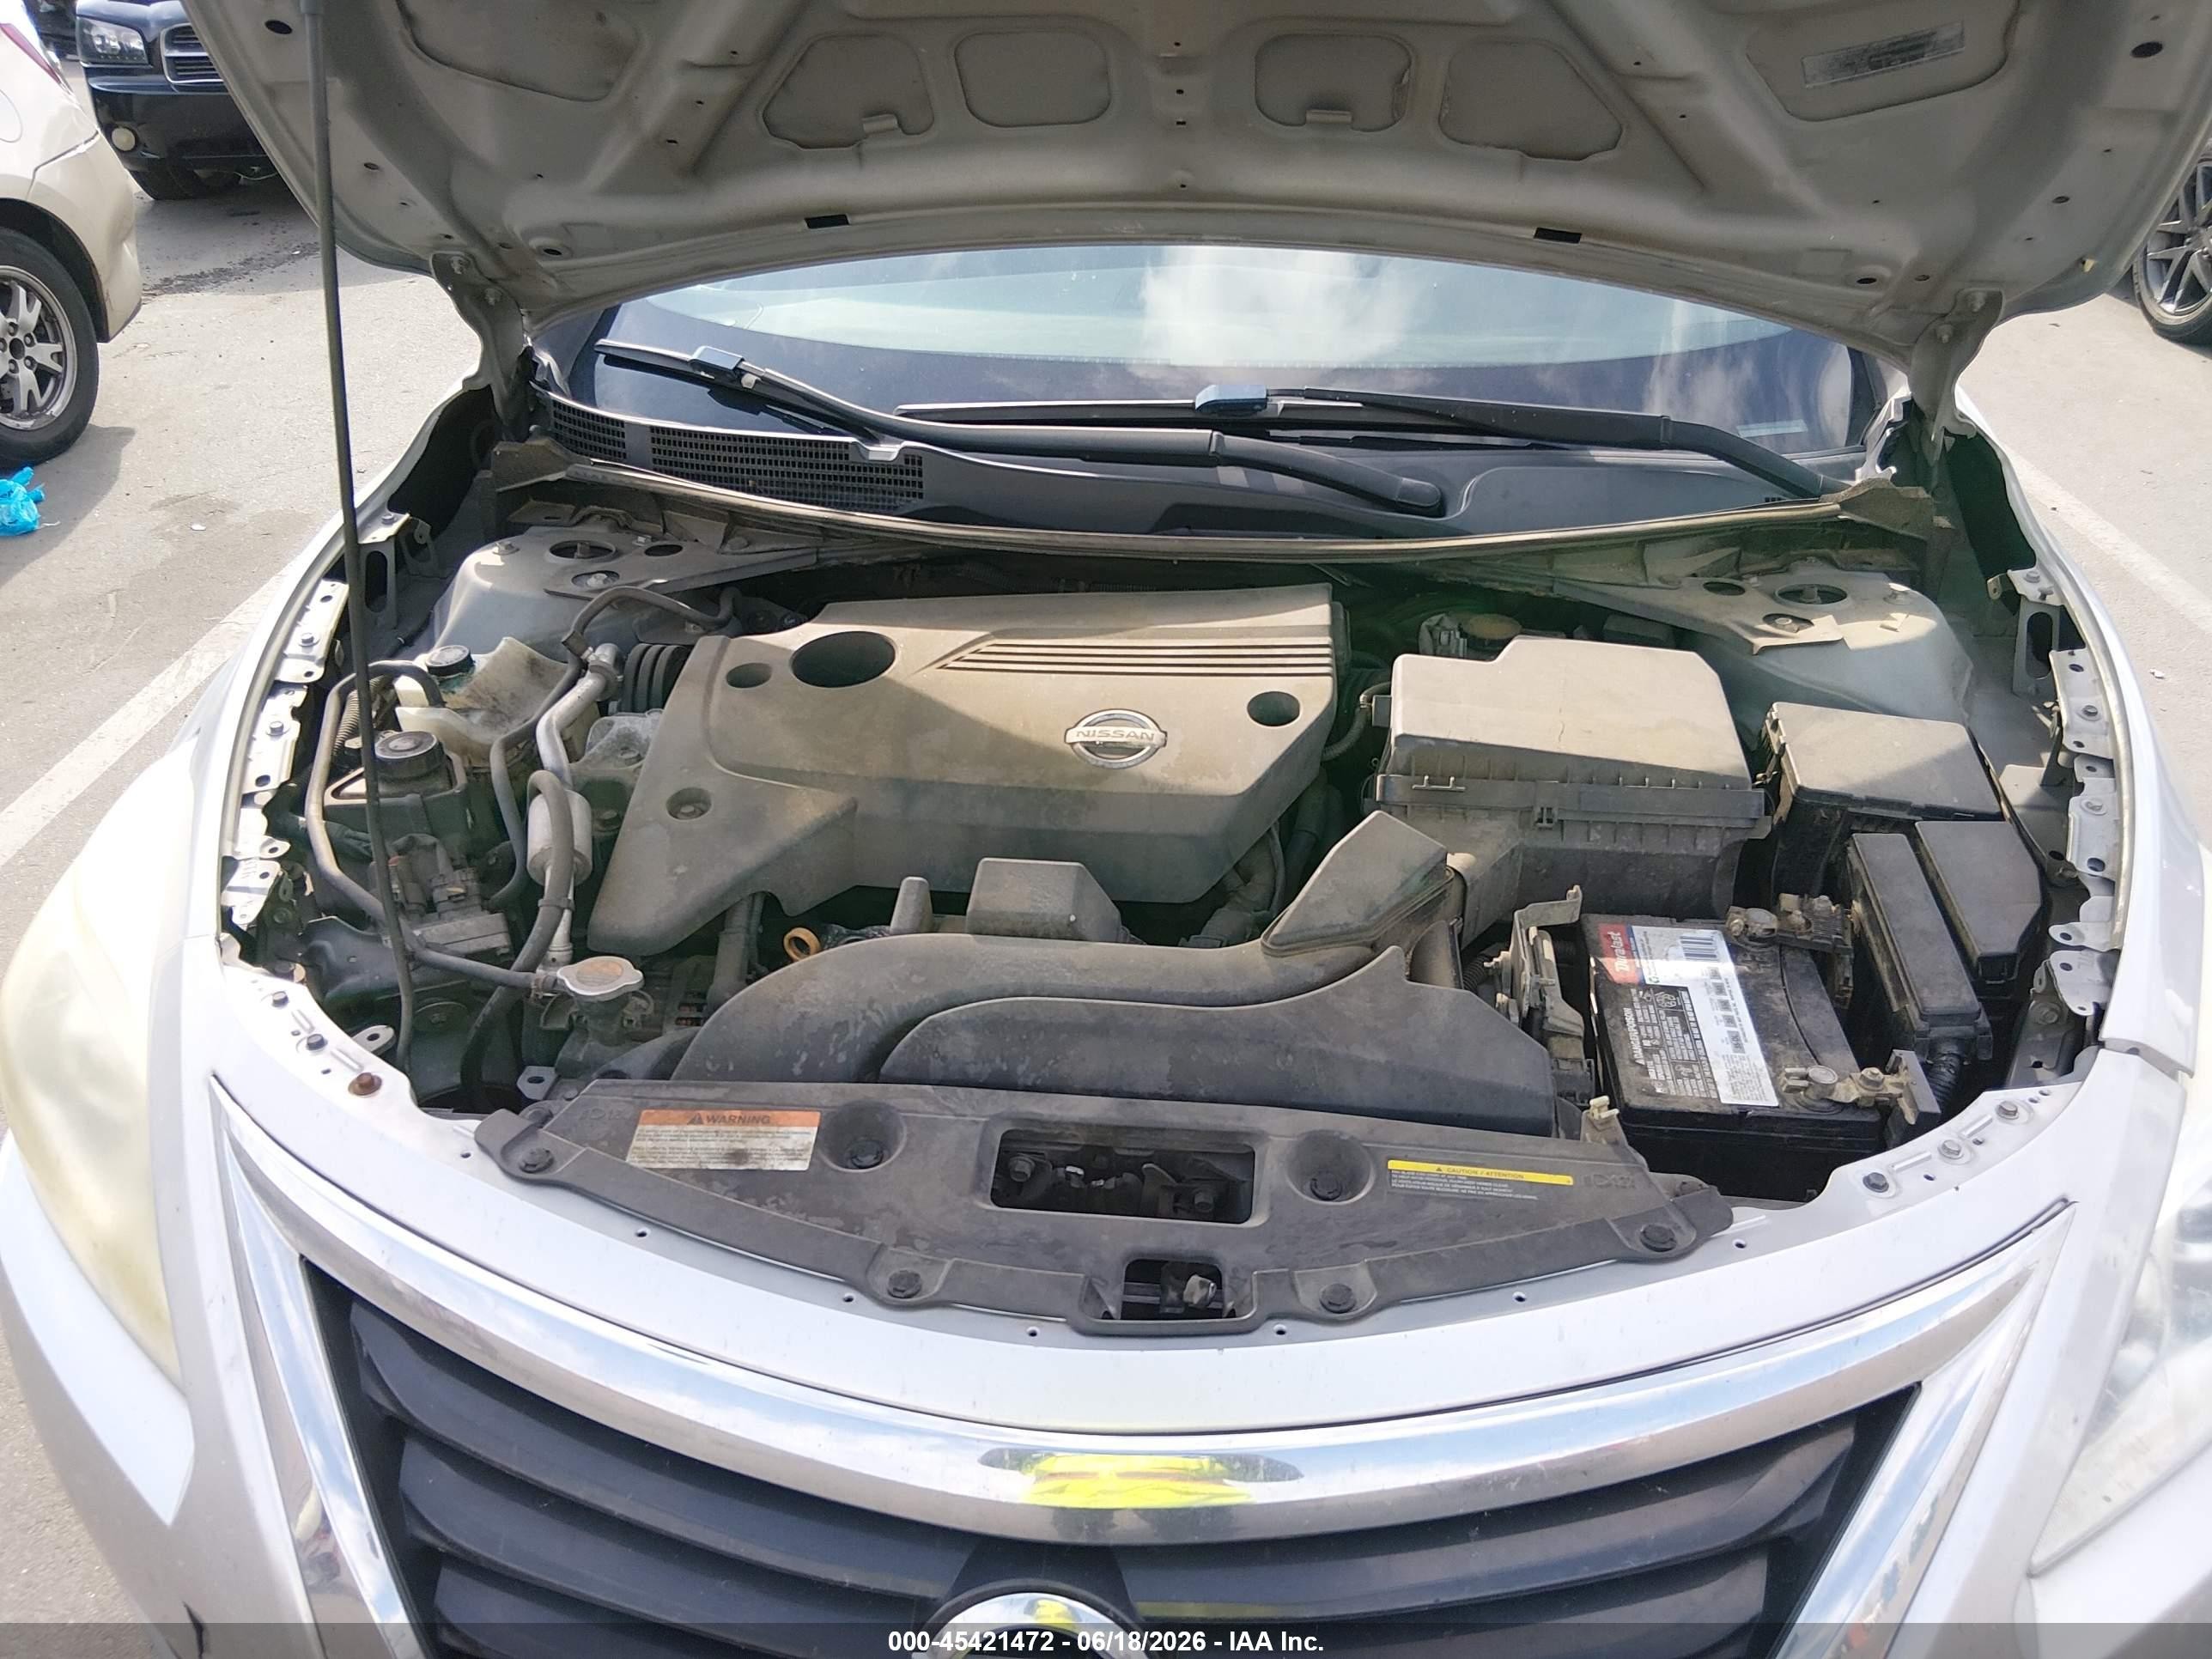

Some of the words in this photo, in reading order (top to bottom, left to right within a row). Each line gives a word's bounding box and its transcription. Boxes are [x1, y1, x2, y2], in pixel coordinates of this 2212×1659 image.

[1076, 730, 1154, 740] NISSAN
[1607, 932, 1631, 972] Duralast
[706, 1113, 771, 1124] WARNING
